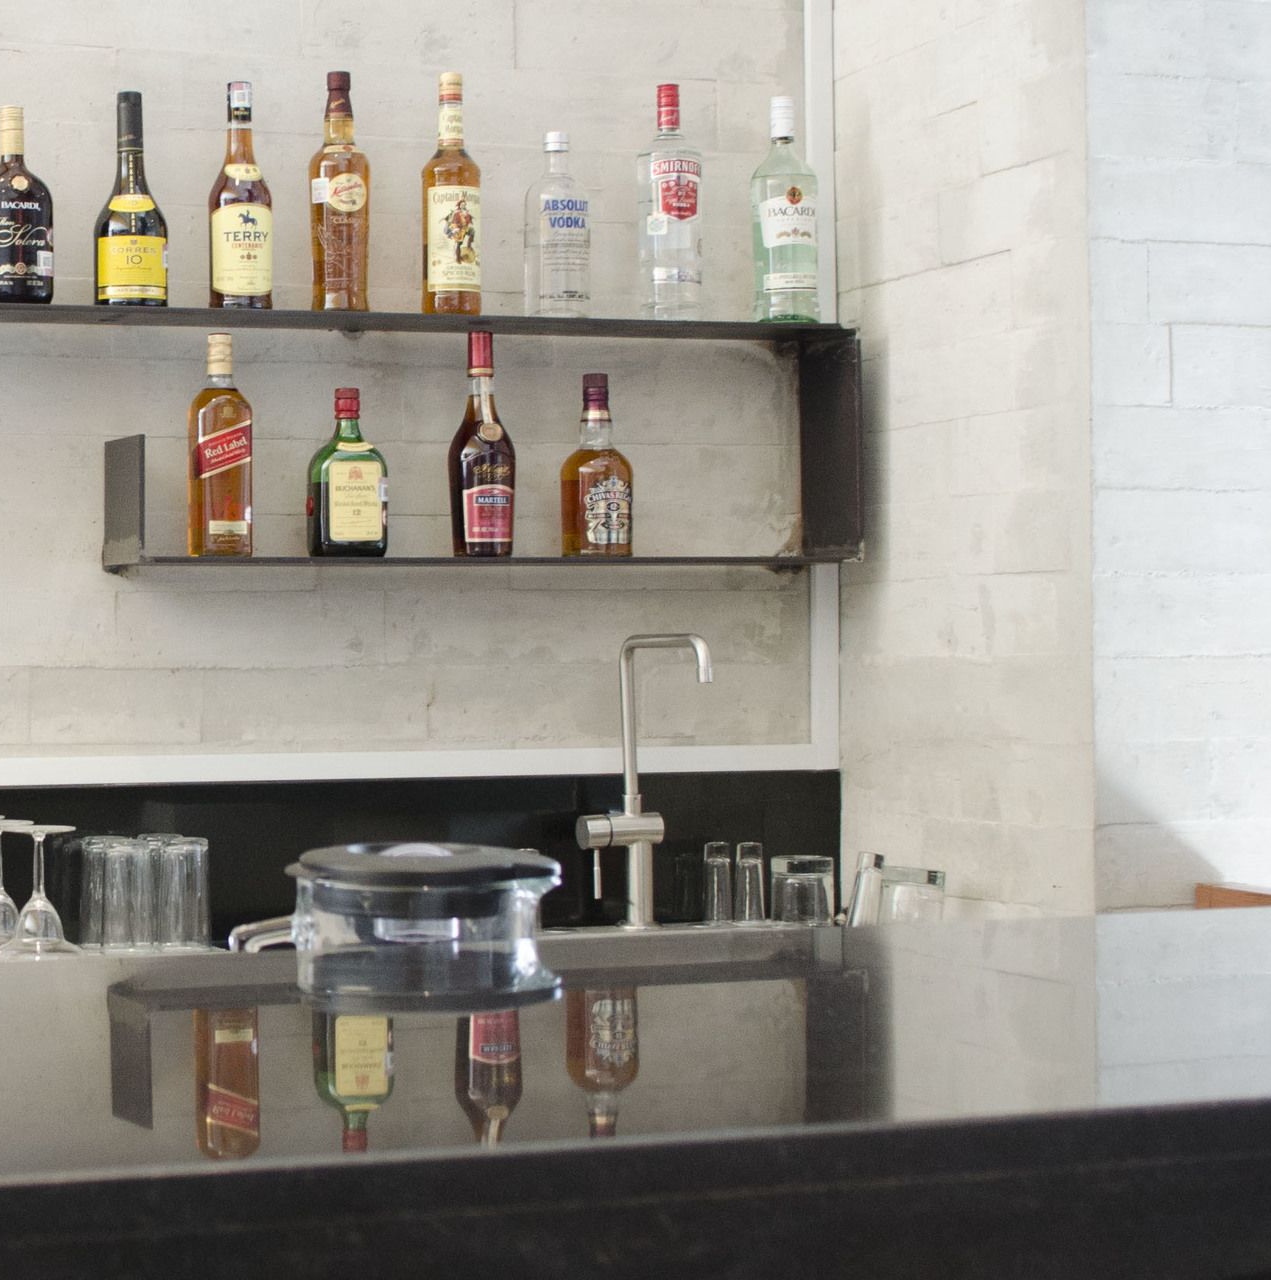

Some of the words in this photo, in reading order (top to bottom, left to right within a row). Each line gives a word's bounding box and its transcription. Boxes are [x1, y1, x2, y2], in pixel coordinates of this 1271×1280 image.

[1, 201, 41, 211] BACARDI
[544, 199, 588, 211] ABSOLUT
[549, 217, 585, 228] VODKA
[224, 231, 269, 241] TERRY
[126, 255, 143, 264] 10
[204, 444, 223, 459] Red
[223, 436, 248, 451] Label
[477, 496, 507, 504] MARTELL
[587, 491, 617, 504] CHIVAS
